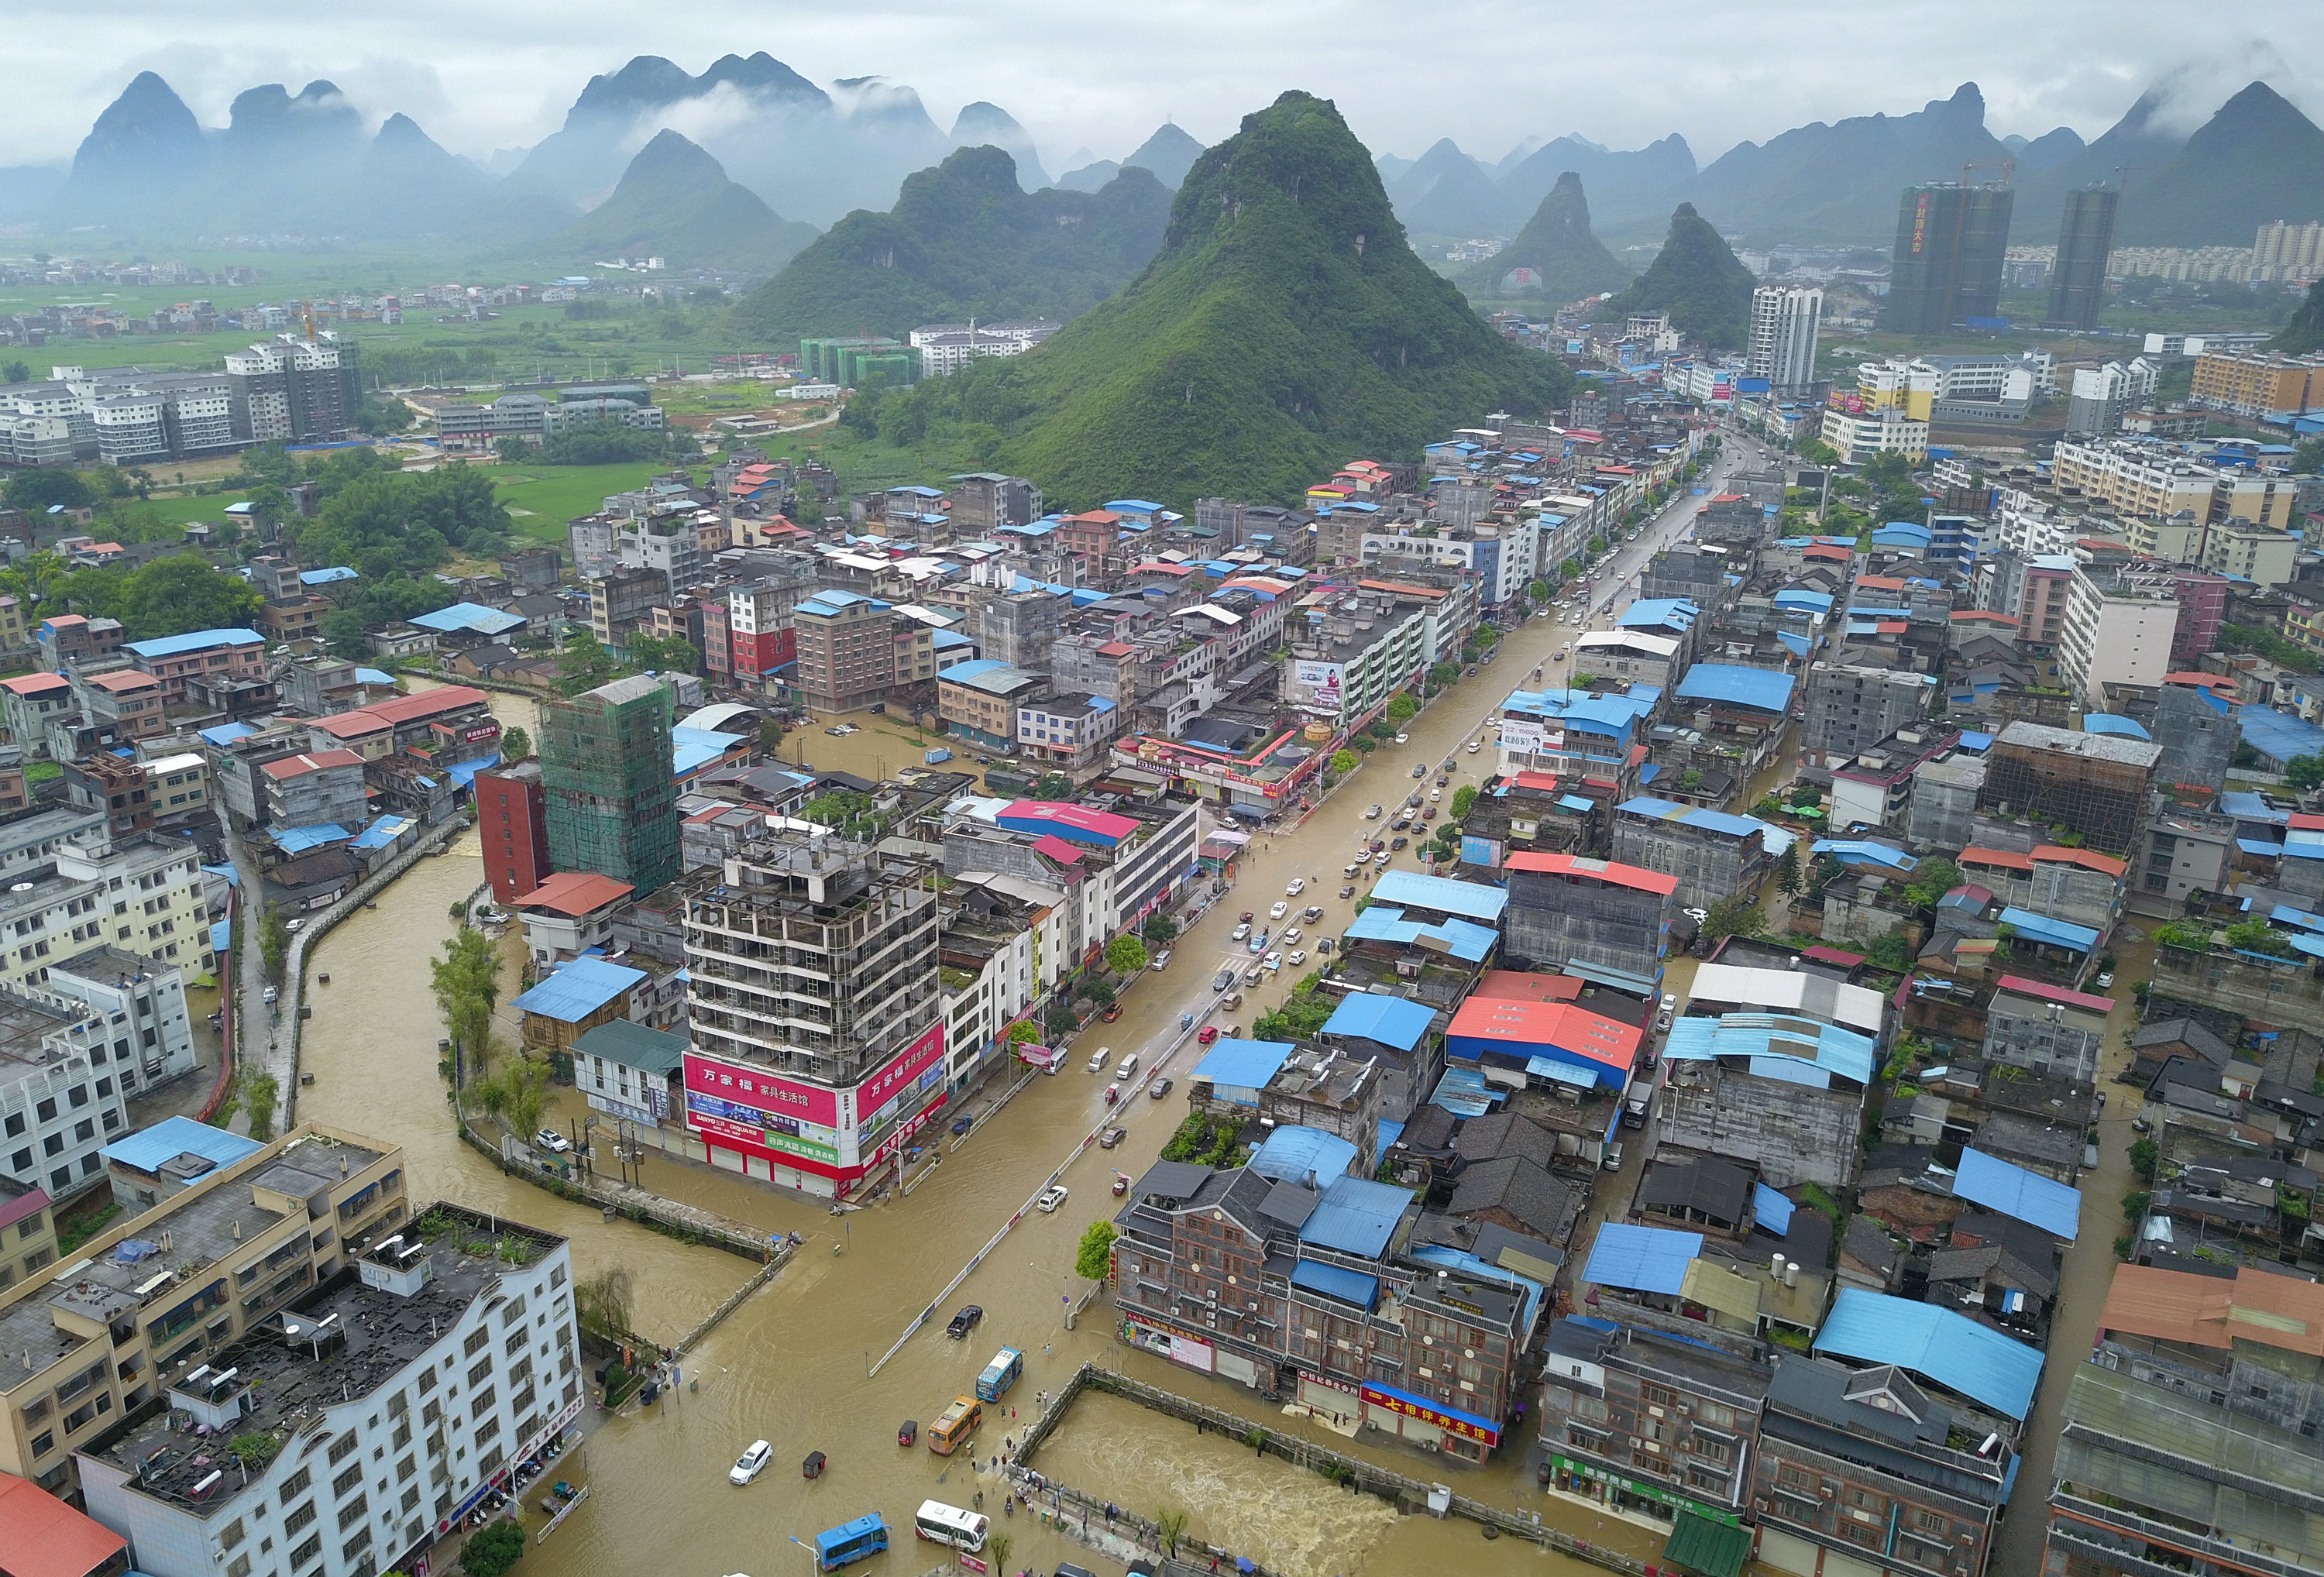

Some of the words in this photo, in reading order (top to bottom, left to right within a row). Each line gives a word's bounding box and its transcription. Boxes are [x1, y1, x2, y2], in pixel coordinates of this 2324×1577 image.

[1913, 208, 1926, 253] 封顶大吉
[1516, 269, 1531, 283] 龍
[703, 1068, 753, 1092] 万家福
[760, 1084, 810, 1108] 家具生活馆
[871, 1064, 903, 1098] 万家福
[904, 1039, 934, 1070] 家具生活馆
[696, 1115, 716, 1125] SANYO
[769, 1136, 799, 1151] 容声冰箱
[815, 1149, 835, 1161] 洗衣机
[1385, 1398, 1486, 1440] 七相伴养生馆
